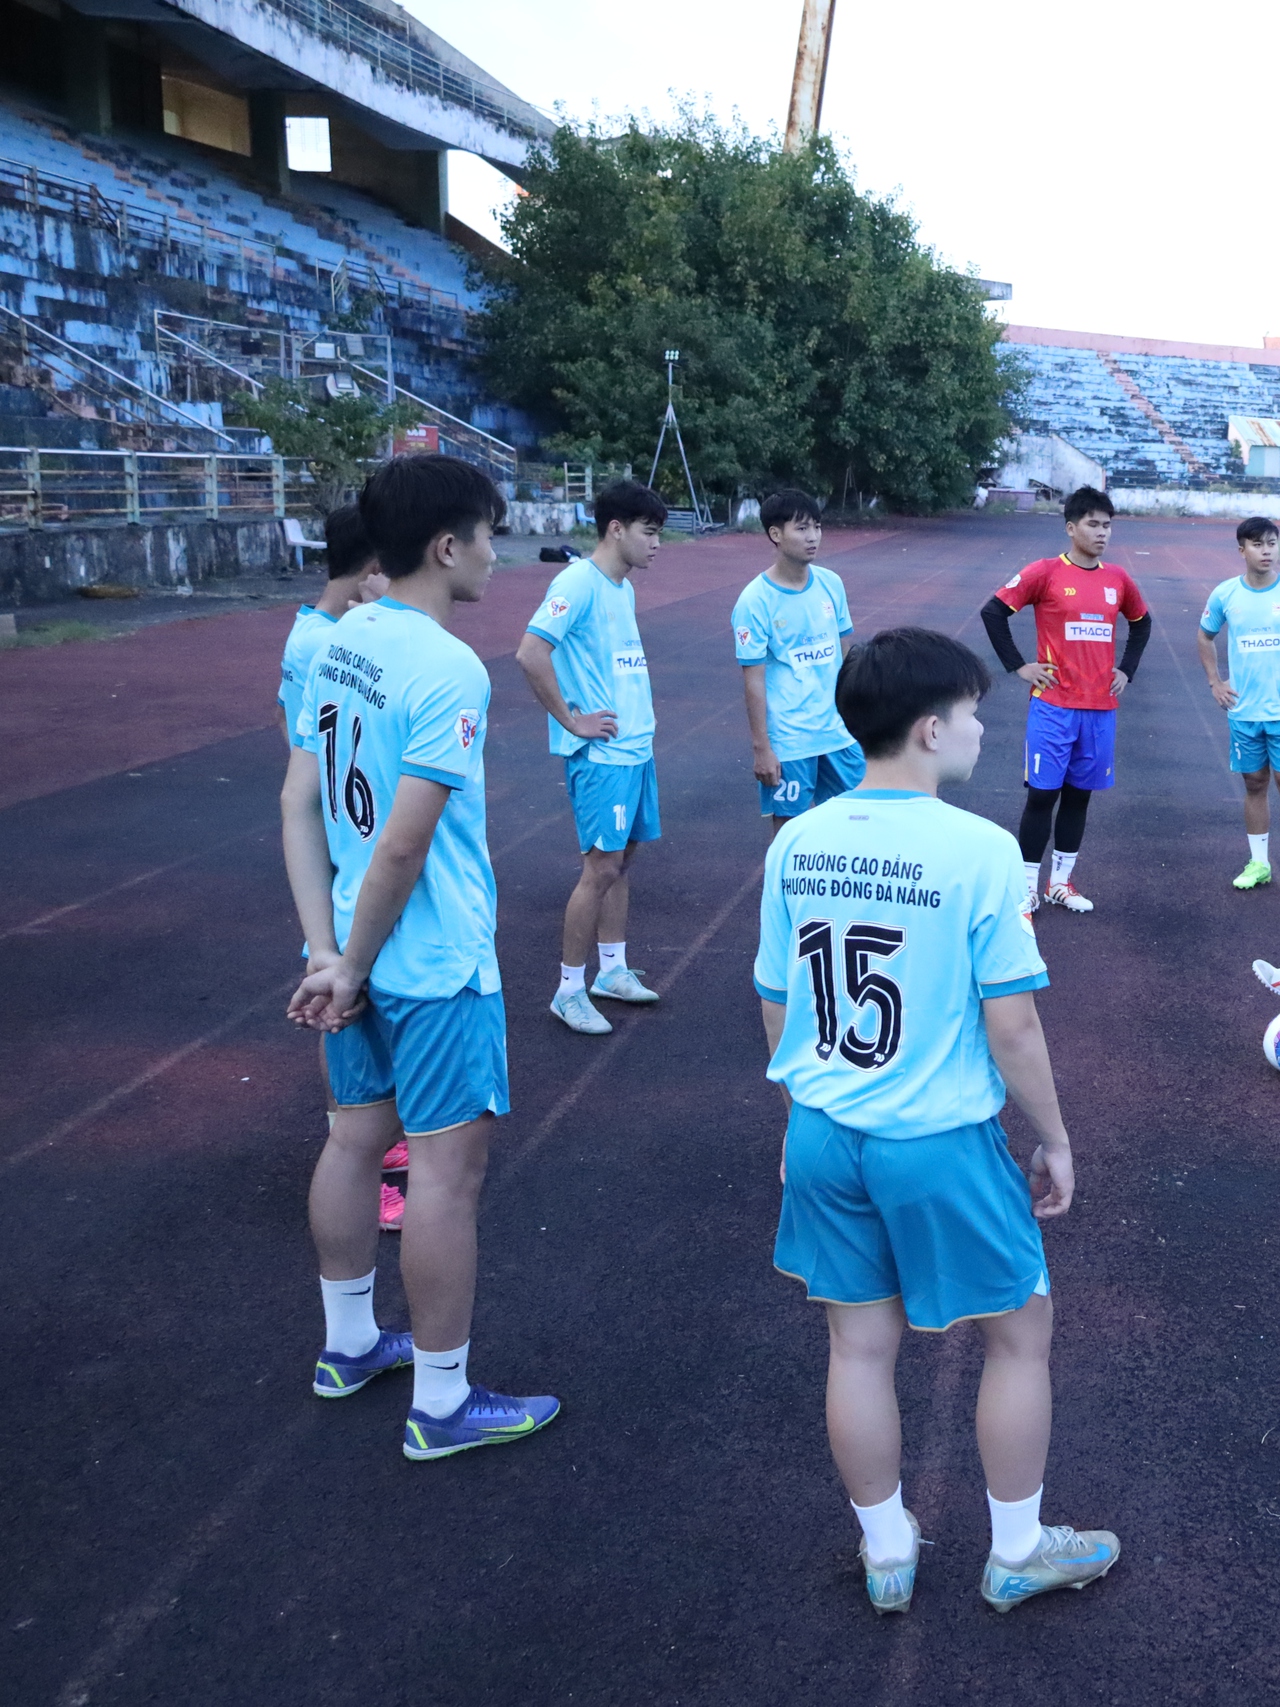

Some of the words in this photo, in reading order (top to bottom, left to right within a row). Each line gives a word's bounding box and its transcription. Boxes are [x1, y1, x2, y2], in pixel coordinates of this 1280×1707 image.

[1070, 626, 1111, 637] THACO
[1241, 638, 1280, 648] THACO
[318, 700, 377, 844] 16
[1034, 753, 1041, 774] 1
[773, 778, 800, 803] 20
[793, 850, 848, 873] TRƯỜNG
[851, 856, 878, 876] CAO
[882, 853, 923, 882] ĐẲNG
[781, 876, 827, 897] PHƯƠNG
[830, 876, 873, 900] ĐÔNG
[876, 880, 893, 903] ĐÀ
[896, 881, 941, 909] NẴNG
[794, 917, 907, 1074] 15
